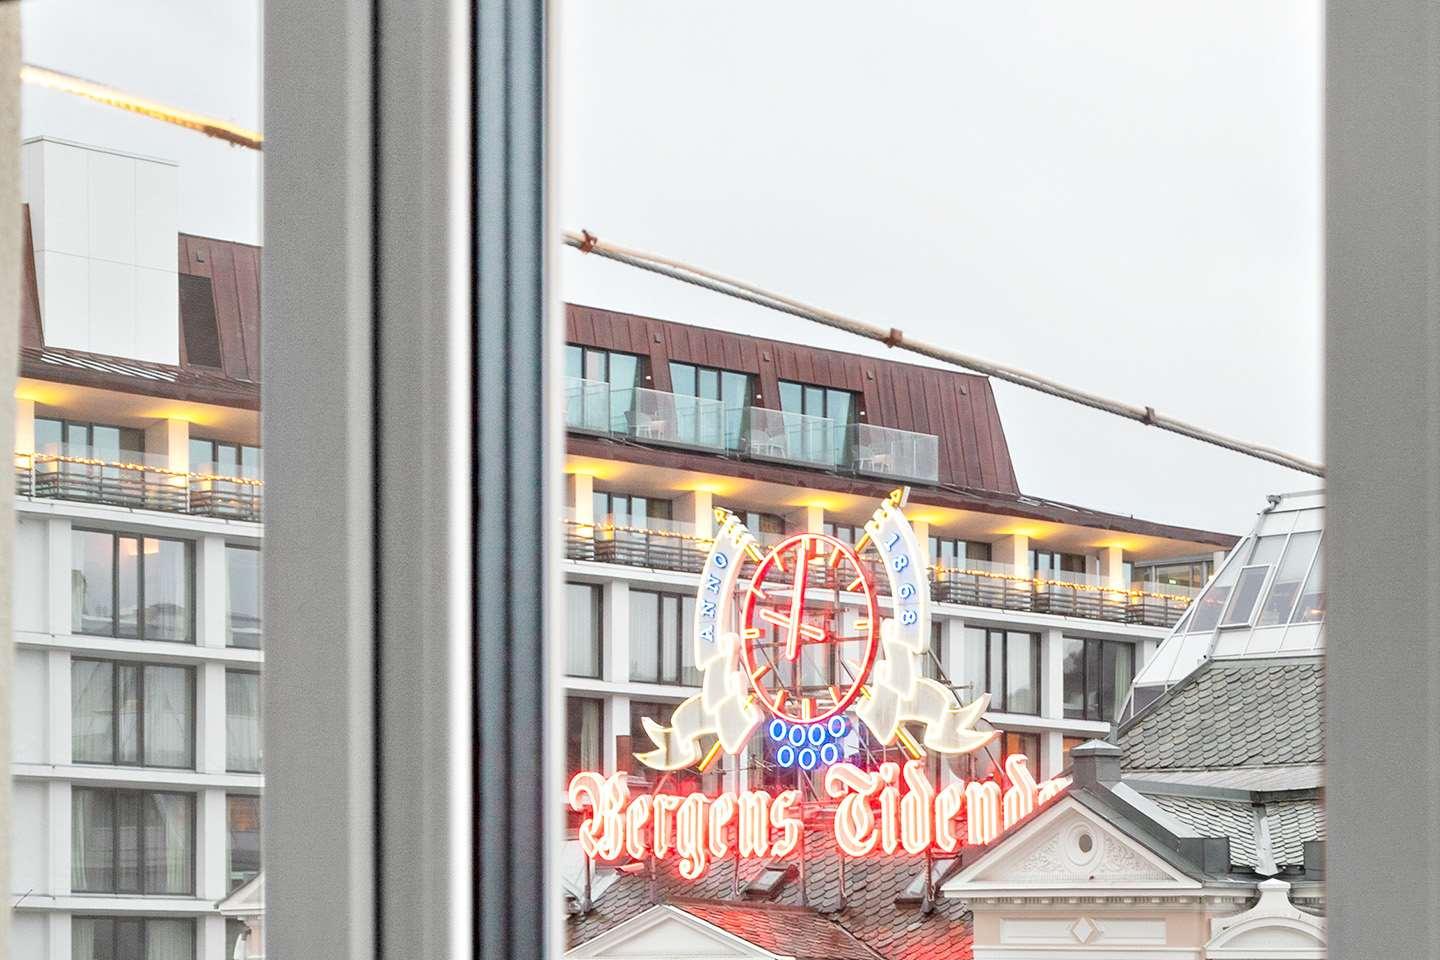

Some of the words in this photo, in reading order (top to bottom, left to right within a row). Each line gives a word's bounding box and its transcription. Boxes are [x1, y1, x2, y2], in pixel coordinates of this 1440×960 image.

[701, 552, 728, 642] ANNO
[885, 533, 917, 625] 1868
[569, 771, 802, 880] Bergens
[825, 753, 1074, 858] Tidend
